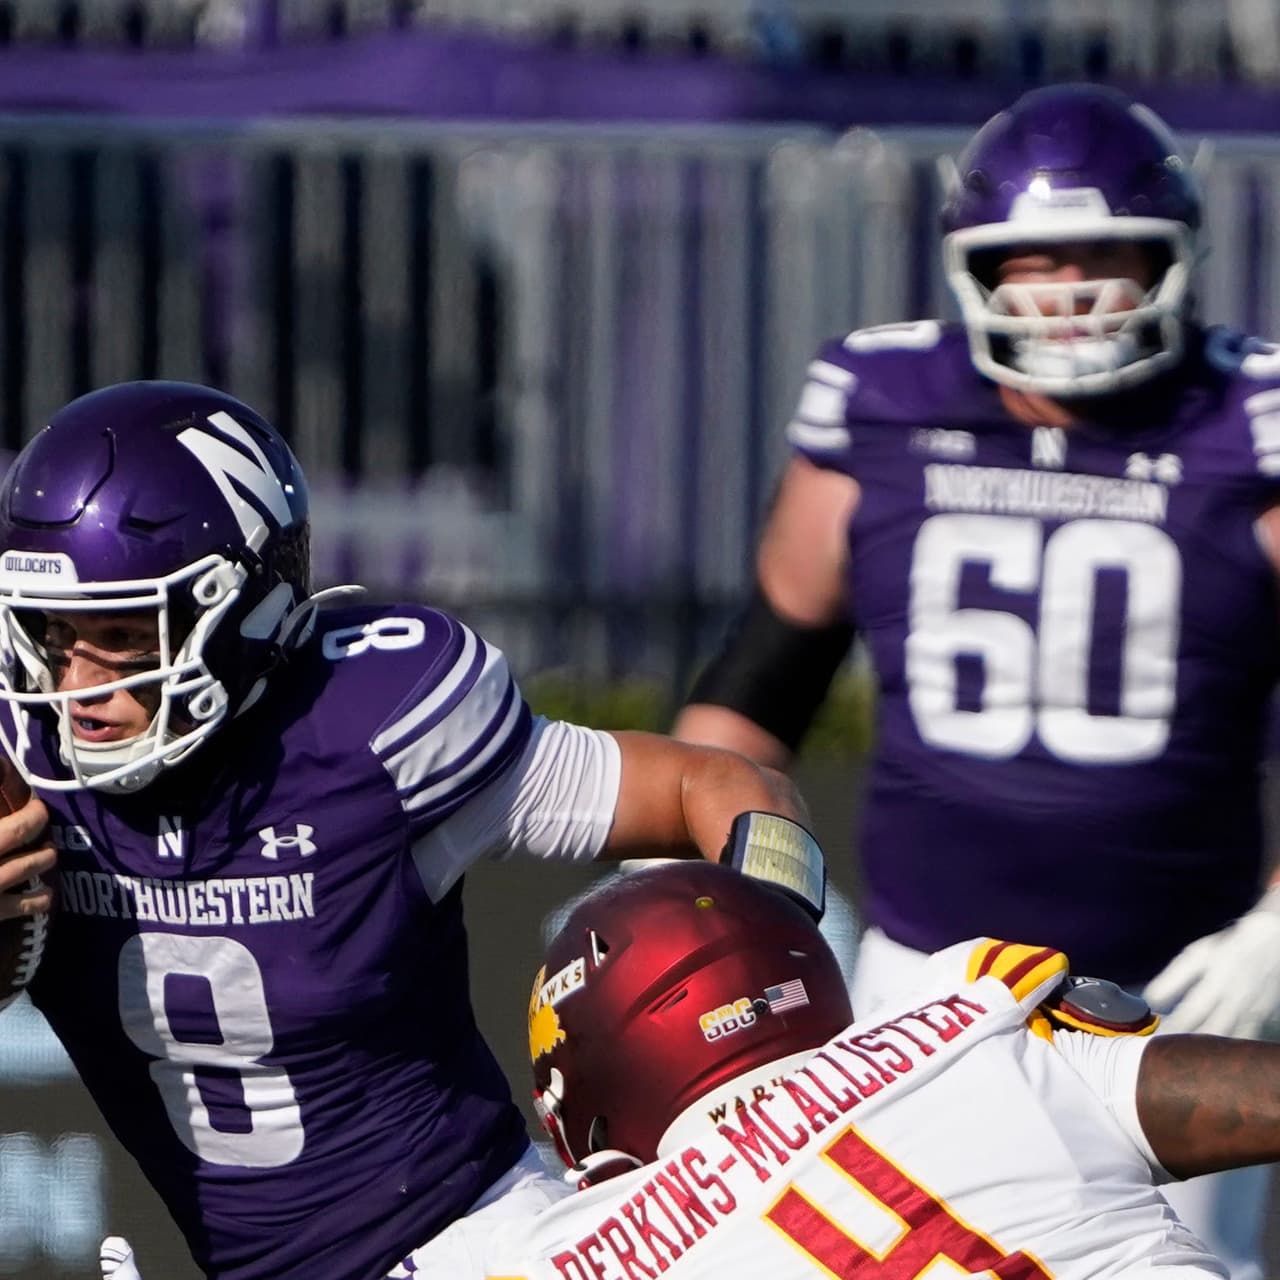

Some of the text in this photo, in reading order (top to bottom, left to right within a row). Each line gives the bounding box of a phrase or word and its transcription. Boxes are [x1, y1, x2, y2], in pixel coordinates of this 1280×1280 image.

[176, 410, 294, 546] N
[5, 556, 62, 575] WILDCATS
[322, 616, 426, 660] 8
[904, 511, 1183, 767] 60
[157, 815, 184, 858] N
[60, 872, 316, 926] NORTHWESTERN
[699, 997, 757, 1042] SBC
[118, 931, 305, 1168] 8
